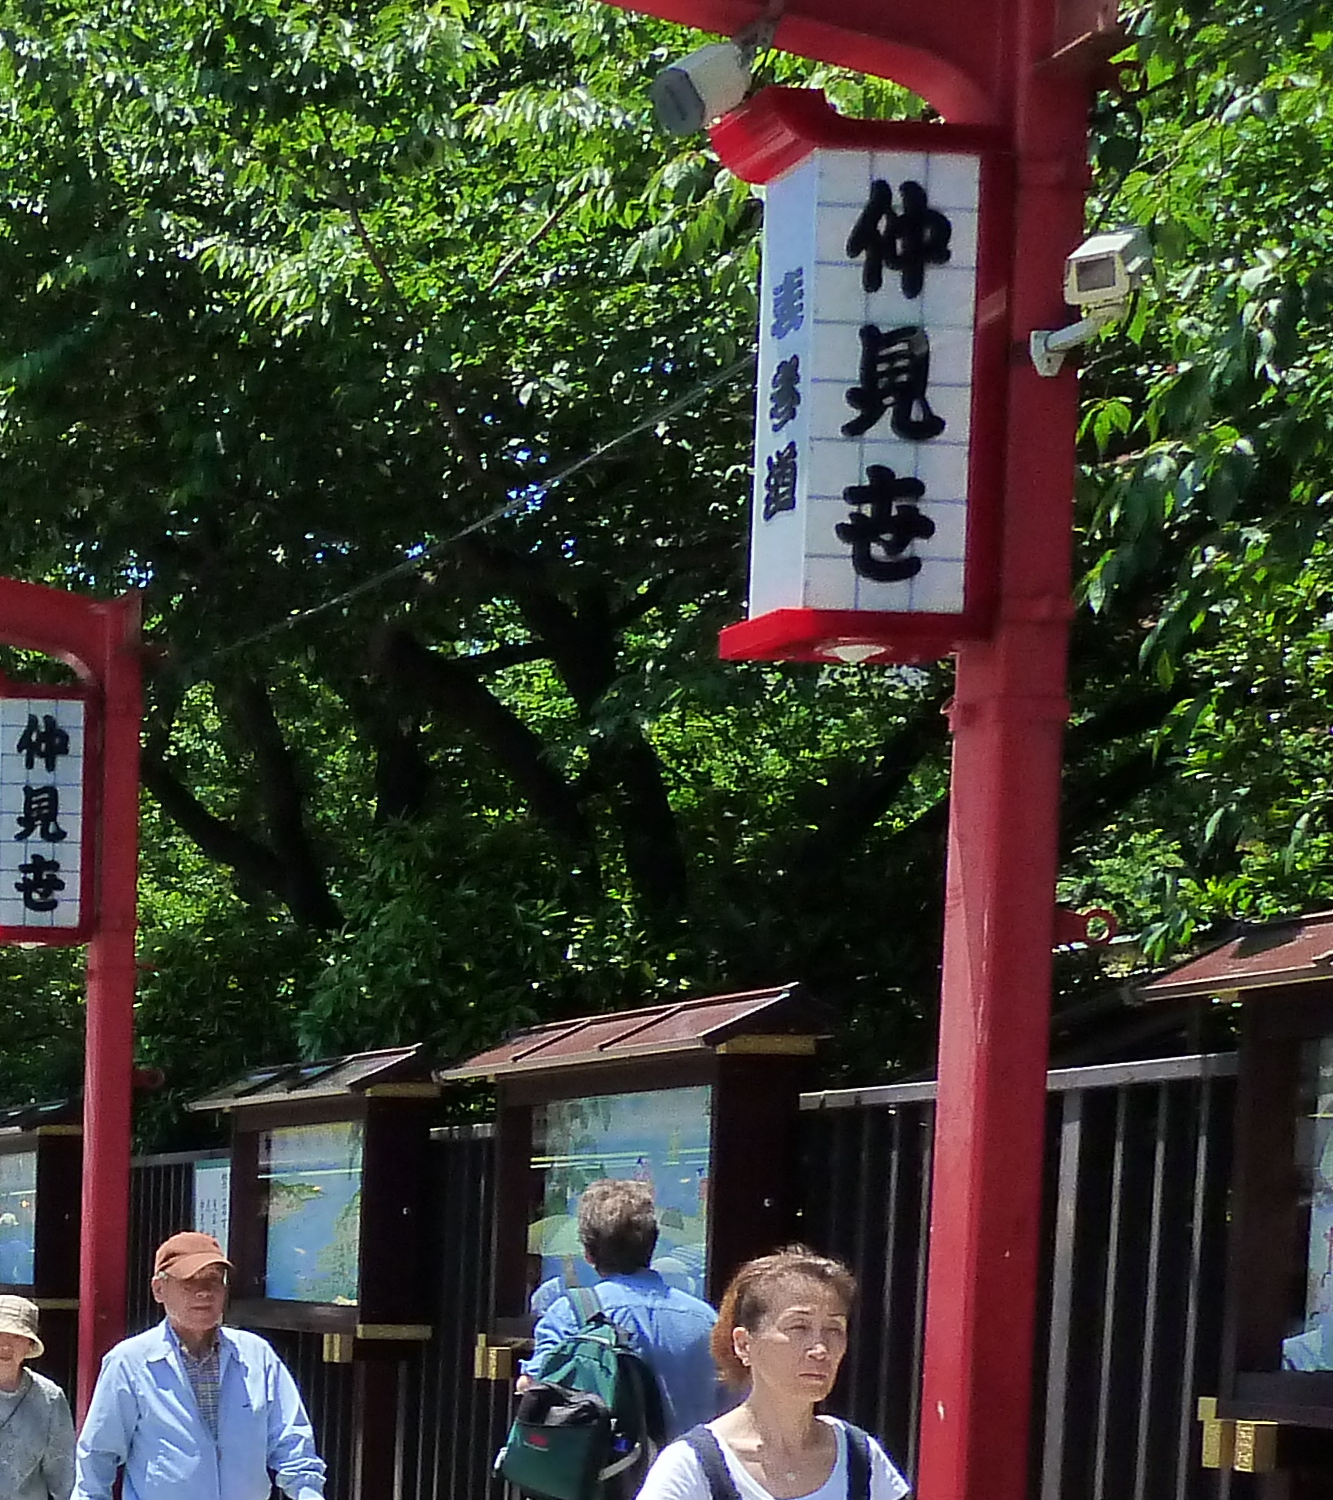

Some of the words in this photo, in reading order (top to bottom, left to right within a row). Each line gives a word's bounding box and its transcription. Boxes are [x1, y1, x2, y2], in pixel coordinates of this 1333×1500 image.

[834, 179, 952, 582] 仲見世
[14, 713, 70, 912] 仲見世
